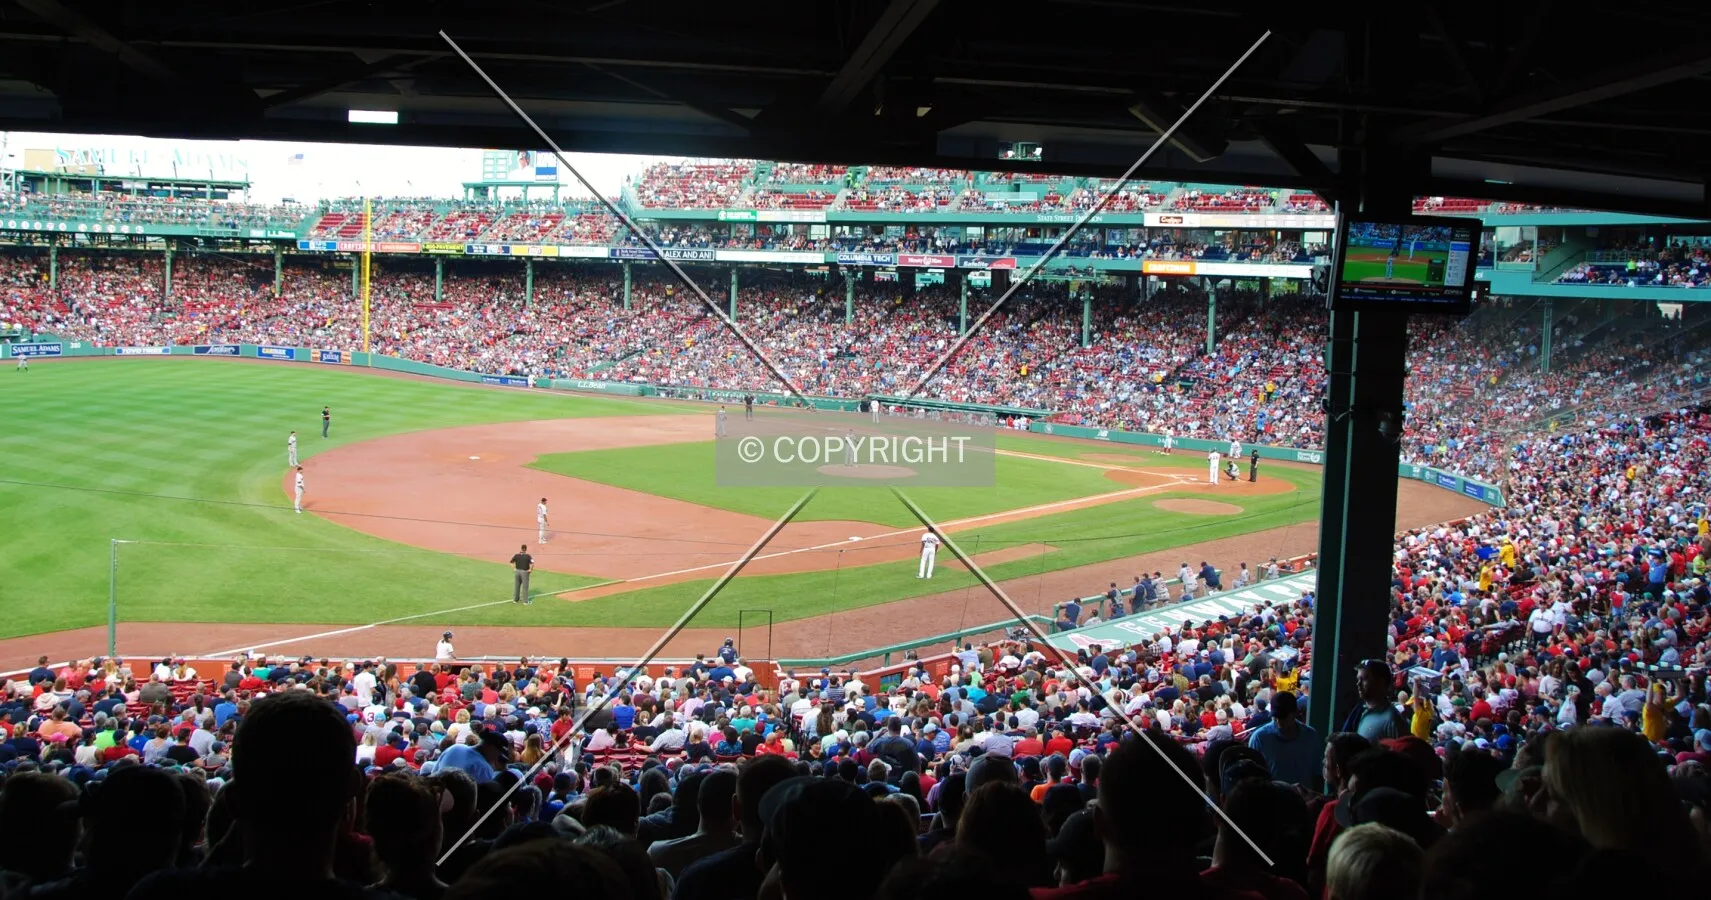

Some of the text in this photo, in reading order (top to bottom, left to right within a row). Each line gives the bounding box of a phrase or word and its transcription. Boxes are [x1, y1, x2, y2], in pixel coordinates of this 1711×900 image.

[665, 250, 713, 260] ALEX AND ANI
[838, 254, 873, 262] COLUMBIA
[873, 255, 891, 263] TECH
[12, 345, 60, 355] SAMUEL ADAMS
[1113, 590, 1275, 637] FENWAY
